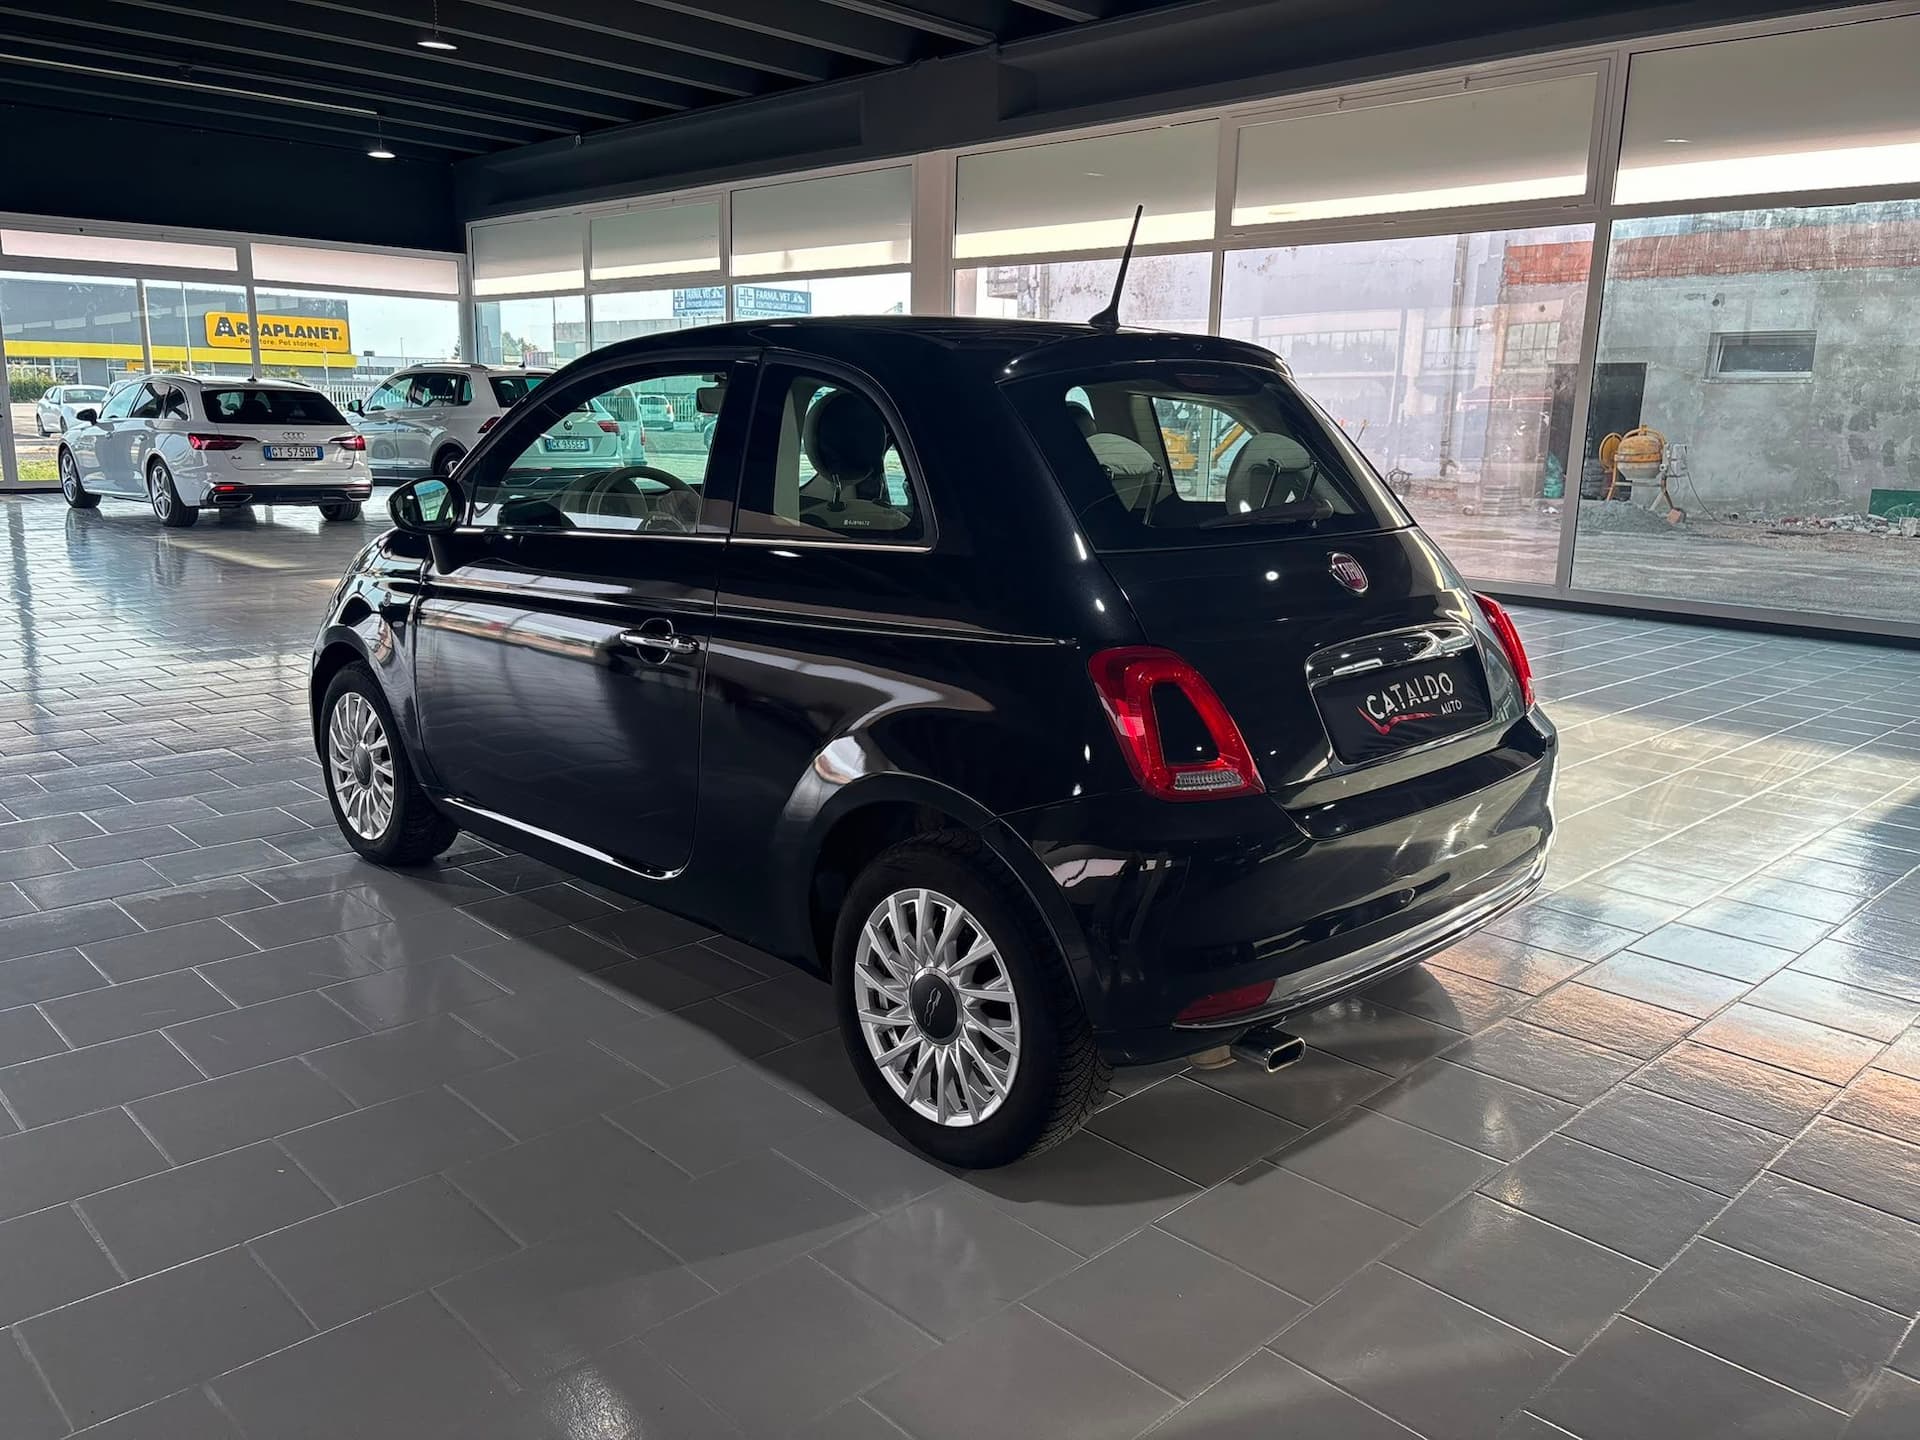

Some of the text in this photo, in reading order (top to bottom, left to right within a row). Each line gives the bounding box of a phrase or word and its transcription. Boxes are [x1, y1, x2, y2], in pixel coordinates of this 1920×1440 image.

[214, 316, 340, 340] ARAPLANET
[1366, 672, 1454, 719] CATALDO
[1440, 699, 1463, 715] AUTO
